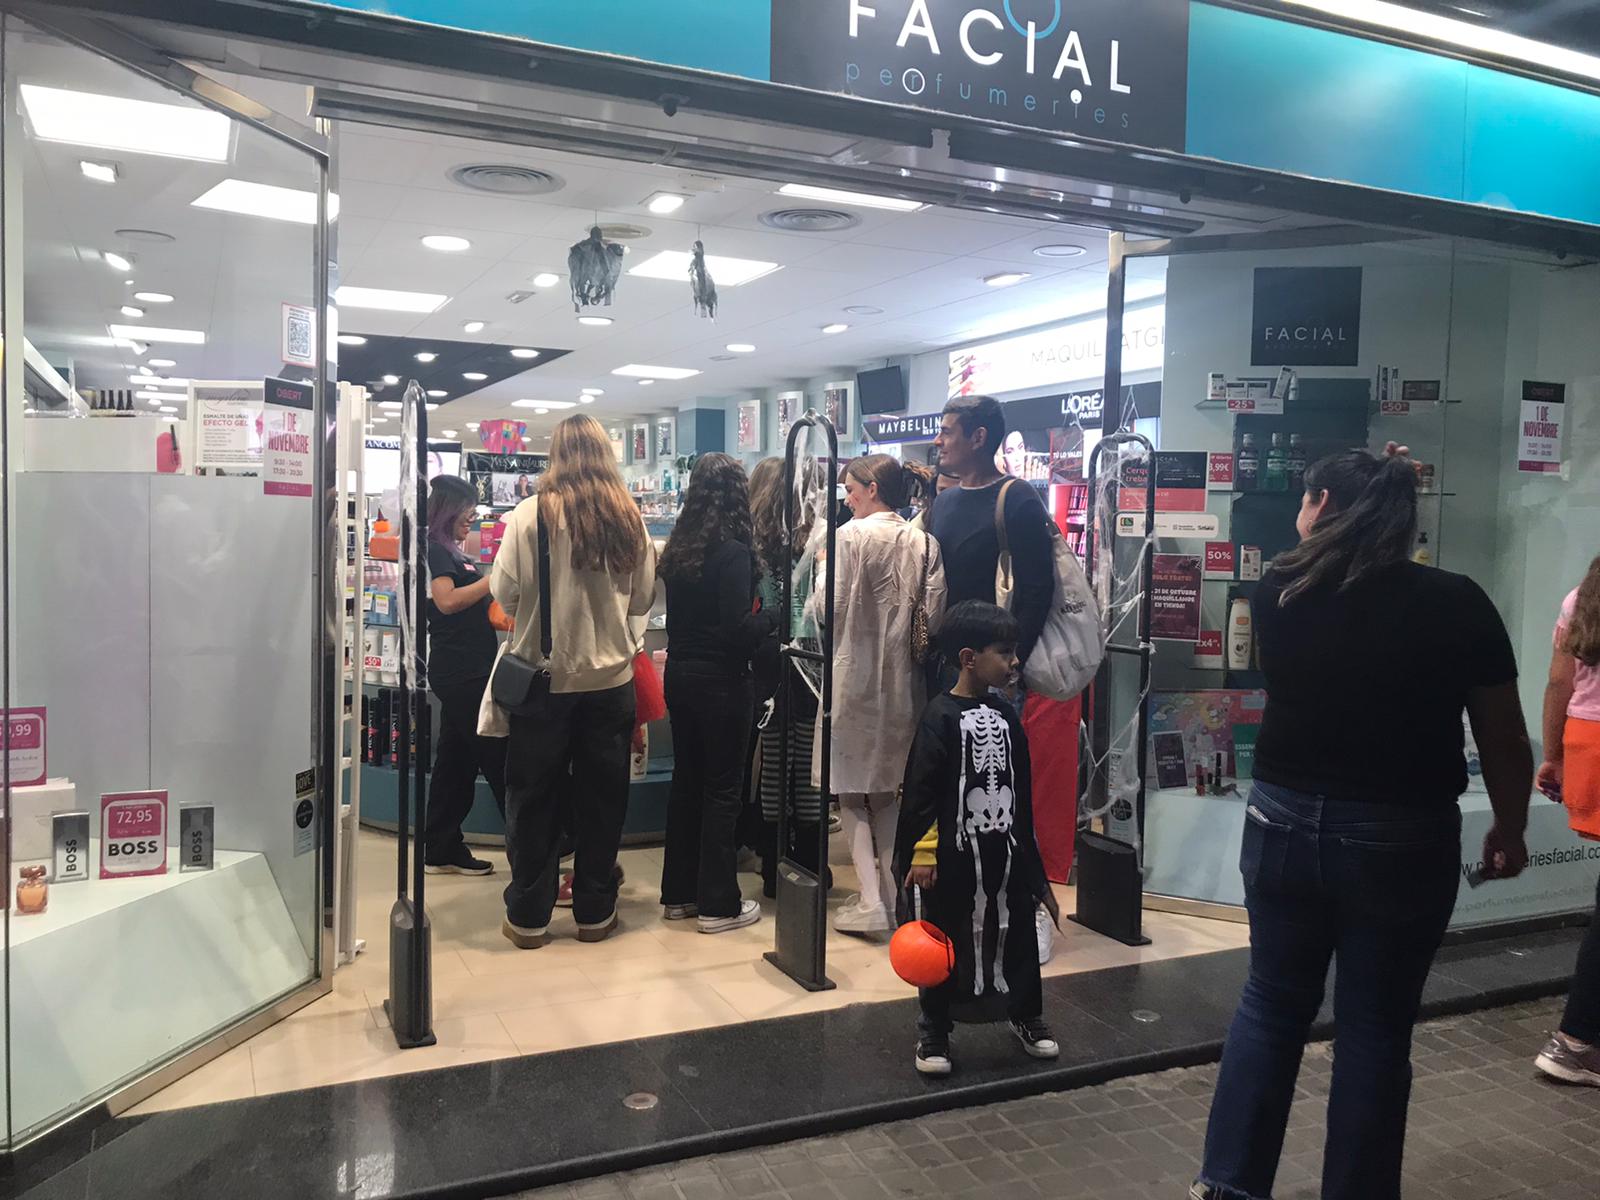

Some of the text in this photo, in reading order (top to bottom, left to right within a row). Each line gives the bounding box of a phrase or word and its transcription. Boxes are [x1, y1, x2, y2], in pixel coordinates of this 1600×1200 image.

[849, 0, 1131, 94] FACIAL
[846, 62, 1129, 128] perfumeries
[1265, 327, 1346, 341] FACIAL
[1031, 326, 1165, 365] MAQUILATG
[1061, 392, 1104, 414] L'ORÉ
[287, 412, 297, 432] DE
[1079, 410, 1100, 419] PARIS
[1541, 406, 1549, 422] DE
[878, 416, 942, 434] MAYBELLIN
[1523, 421, 1559, 439] NOVEMBRE
[268, 431, 309, 454] NOVEMBRE
[366, 439, 400, 449] ANCOM
[1207, 550, 1232, 560] 50%
[116, 809, 152, 825] 72,95
[66, 839, 77, 872] BOSS
[108, 840, 158, 857] BOSS
[192, 830, 202, 863] BOSS
